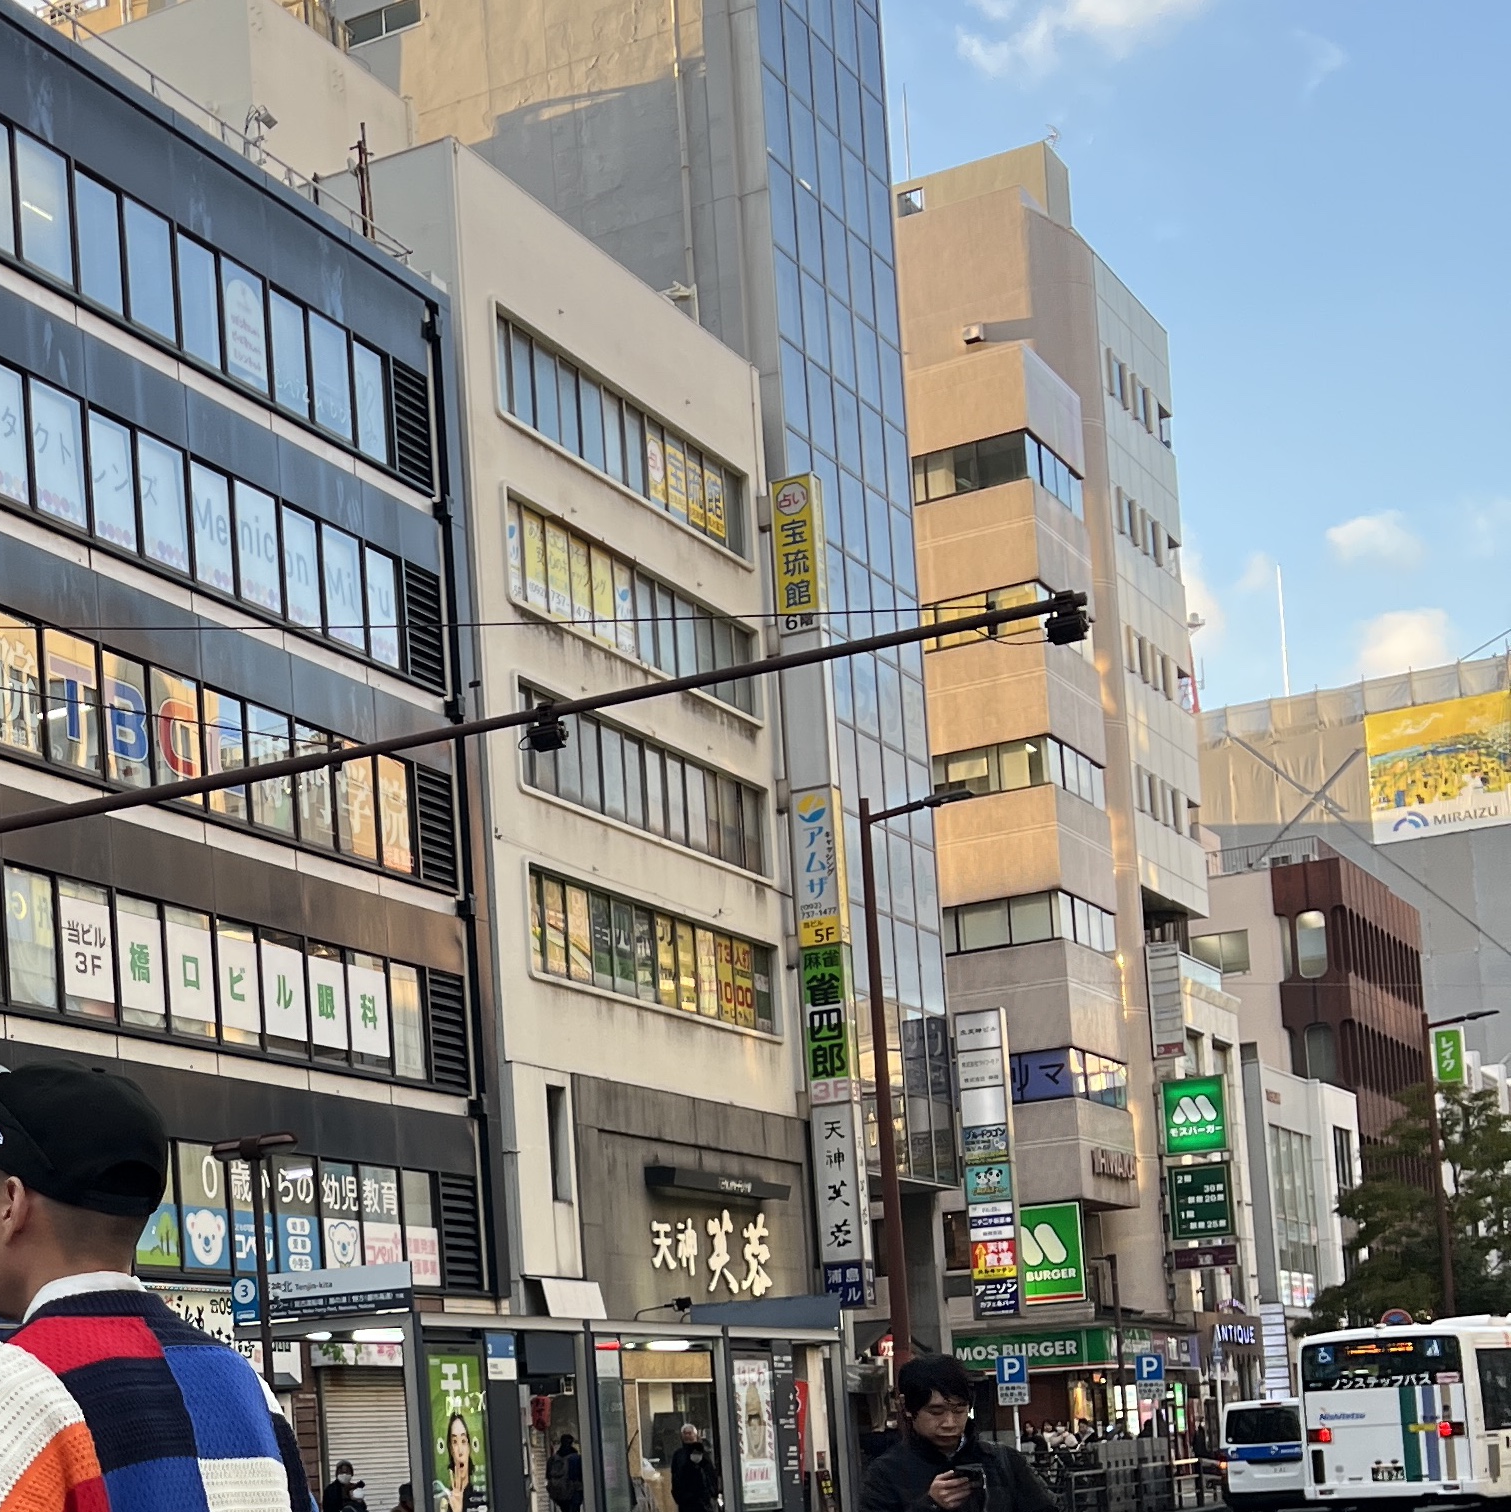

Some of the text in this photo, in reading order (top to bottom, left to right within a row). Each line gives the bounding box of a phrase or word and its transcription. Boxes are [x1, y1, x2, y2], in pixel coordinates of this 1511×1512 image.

[779, 490, 807, 509] 占い
[194, 490, 309, 587] Menicon
[781, 519, 811, 609] 宝琉館
[785, 611, 814, 631] 6階
[1433, 806, 1499, 826] MIRAIZU
[802, 826, 829, 900] アムザ
[67, 919, 106, 949] 当ビル
[814, 927, 835, 943] 5F
[75, 951, 103, 977] 3F
[803, 949, 840, 971] 麻雀
[128, 940, 379, 1031] 橋口ビル眼科
[806, 972, 847, 1079] 雀四郎
[1440, 1036, 1456, 1072] レイク
[813, 1079, 849, 1101] 3F
[1169, 1124, 1223, 1138] モスバーガー
[1025, 1267, 1077, 1282] BURGER
[240, 1284, 249, 1298] 3
[267, 1280, 294, 1293] 神北
[974, 1282, 1018, 1296] アニソン
[956, 1339, 1078, 1362] MOS BURGER
[1003, 1357, 1021, 1382] P
[1141, 1356, 1159, 1379] P
[1331, 1371, 1432, 1390] ノンステップバス
[1319, 1411, 1366, 1422] Nishitetsu
